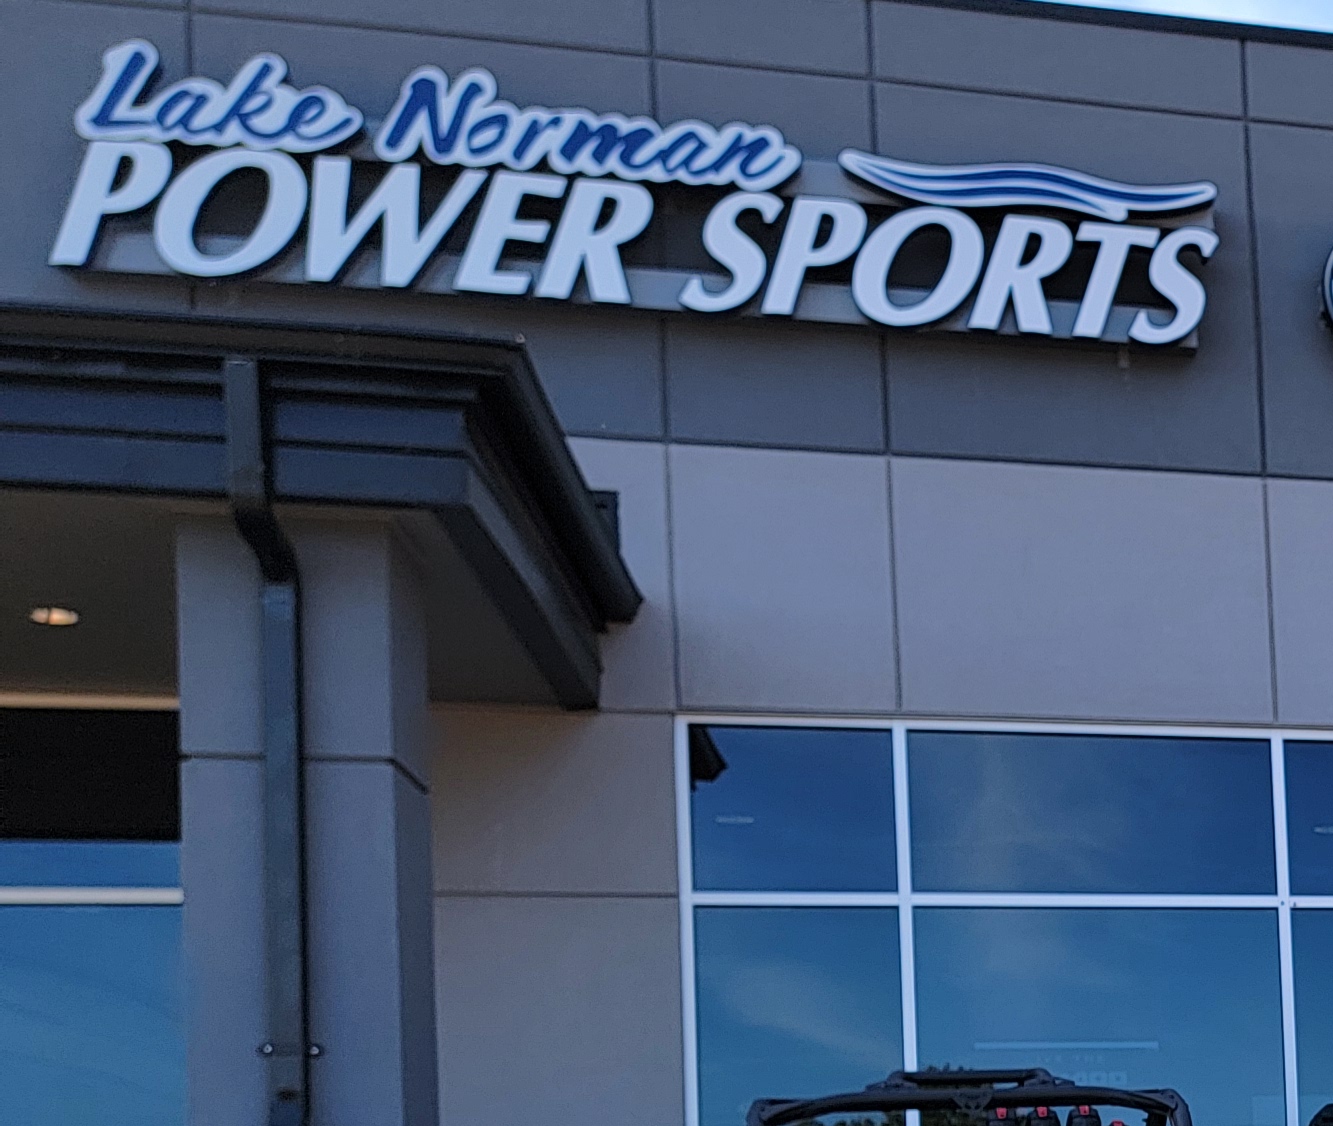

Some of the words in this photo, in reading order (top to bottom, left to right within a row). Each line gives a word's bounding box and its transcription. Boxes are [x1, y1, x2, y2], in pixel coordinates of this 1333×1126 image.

[83, 44, 359, 147] Lake
[378, 68, 797, 187] Norman
[48, 140, 654, 304] POWER
[678, 192, 1220, 345] SPORTS
